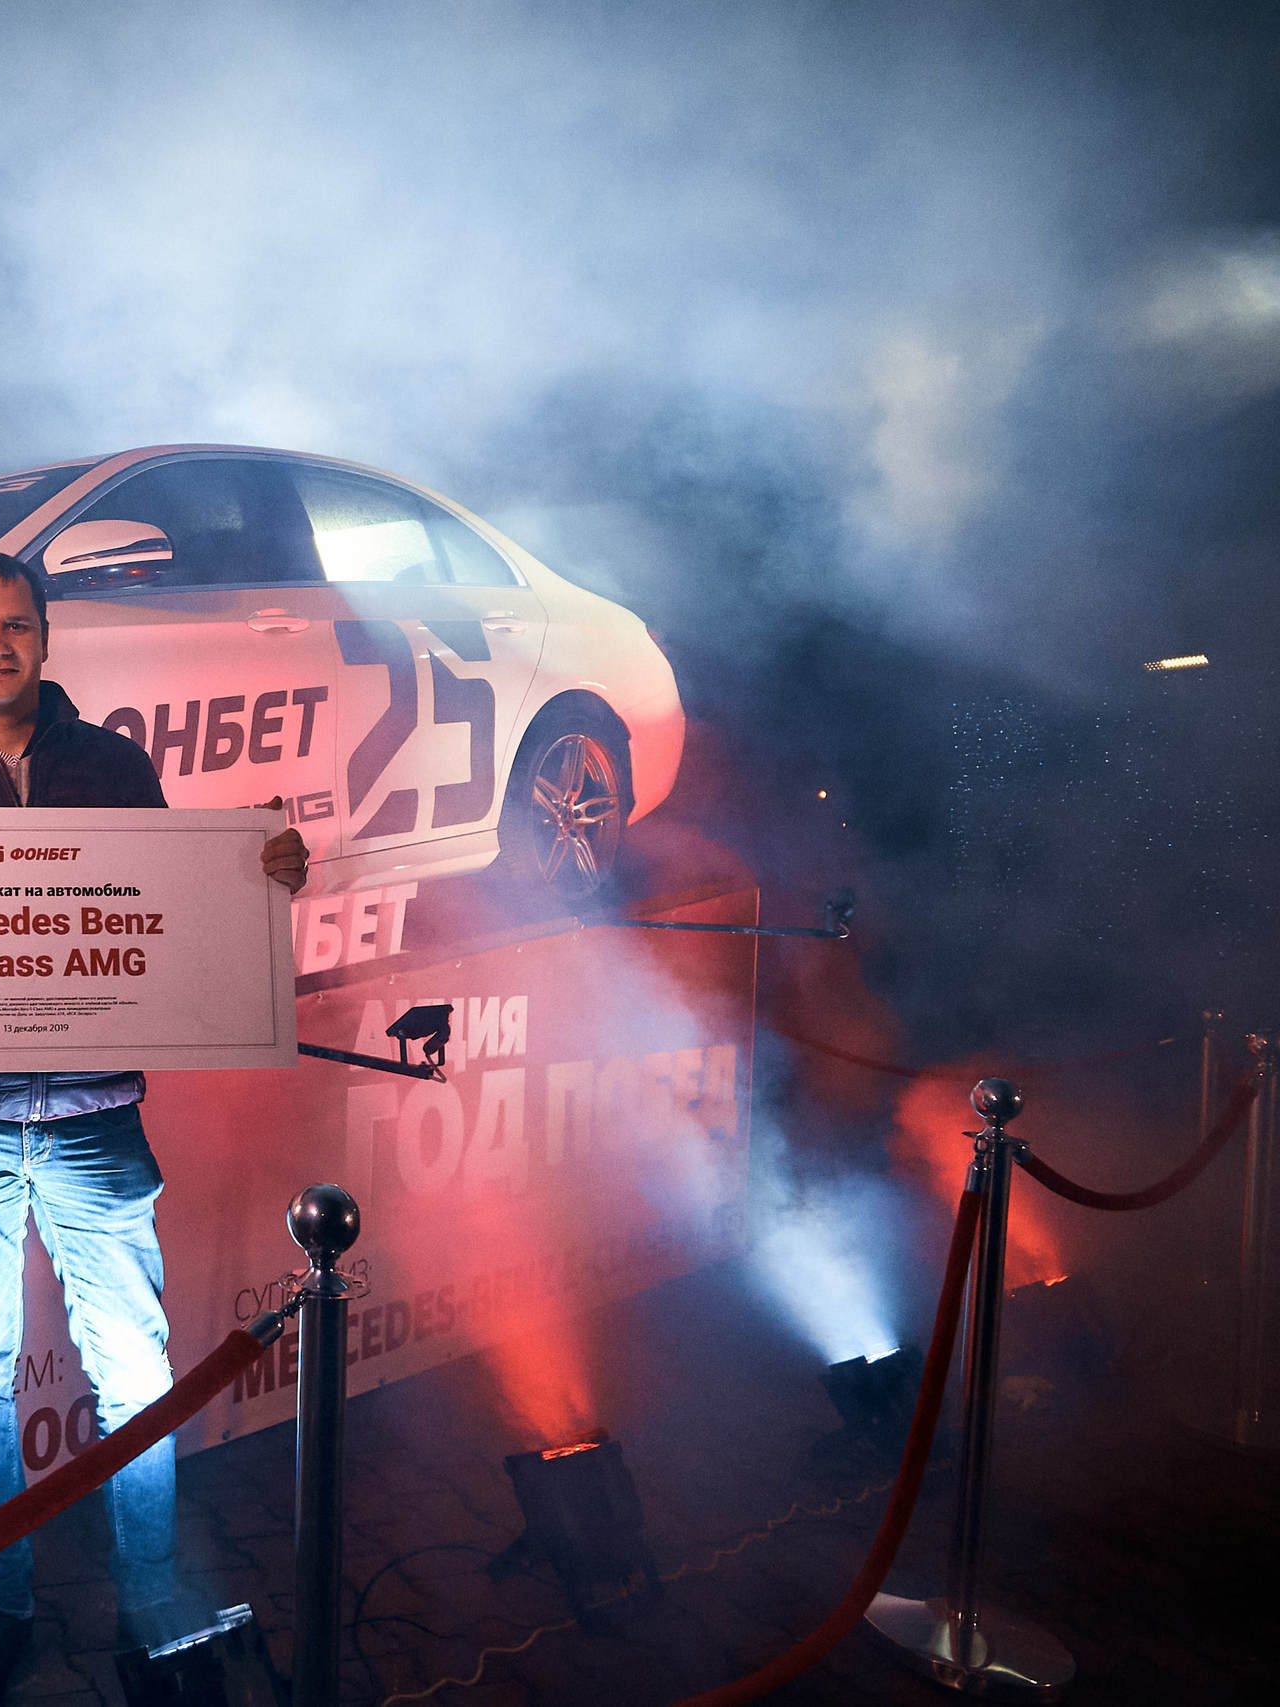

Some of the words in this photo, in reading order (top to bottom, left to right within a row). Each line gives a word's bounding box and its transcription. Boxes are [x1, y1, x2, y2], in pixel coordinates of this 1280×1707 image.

[101, 685, 328, 779] ОНБЕТ
[334, 619, 495, 841] 25
[10, 847, 81, 861] ФОНБЕТ
[25, 887, 44, 898] на
[47, 883, 141, 898] автомобиль
[81, 907, 164, 934] Benz
[291, 882, 418, 975] БЕТ
[63, 948, 147, 977] AMG
[3, 1024, 12, 1032] 13
[14, 1024, 47, 1034] декабря
[49, 1023, 69, 1032] 2019
[347, 1067, 528, 1208] ГОД
[23, 1394, 99, 1471] 00
